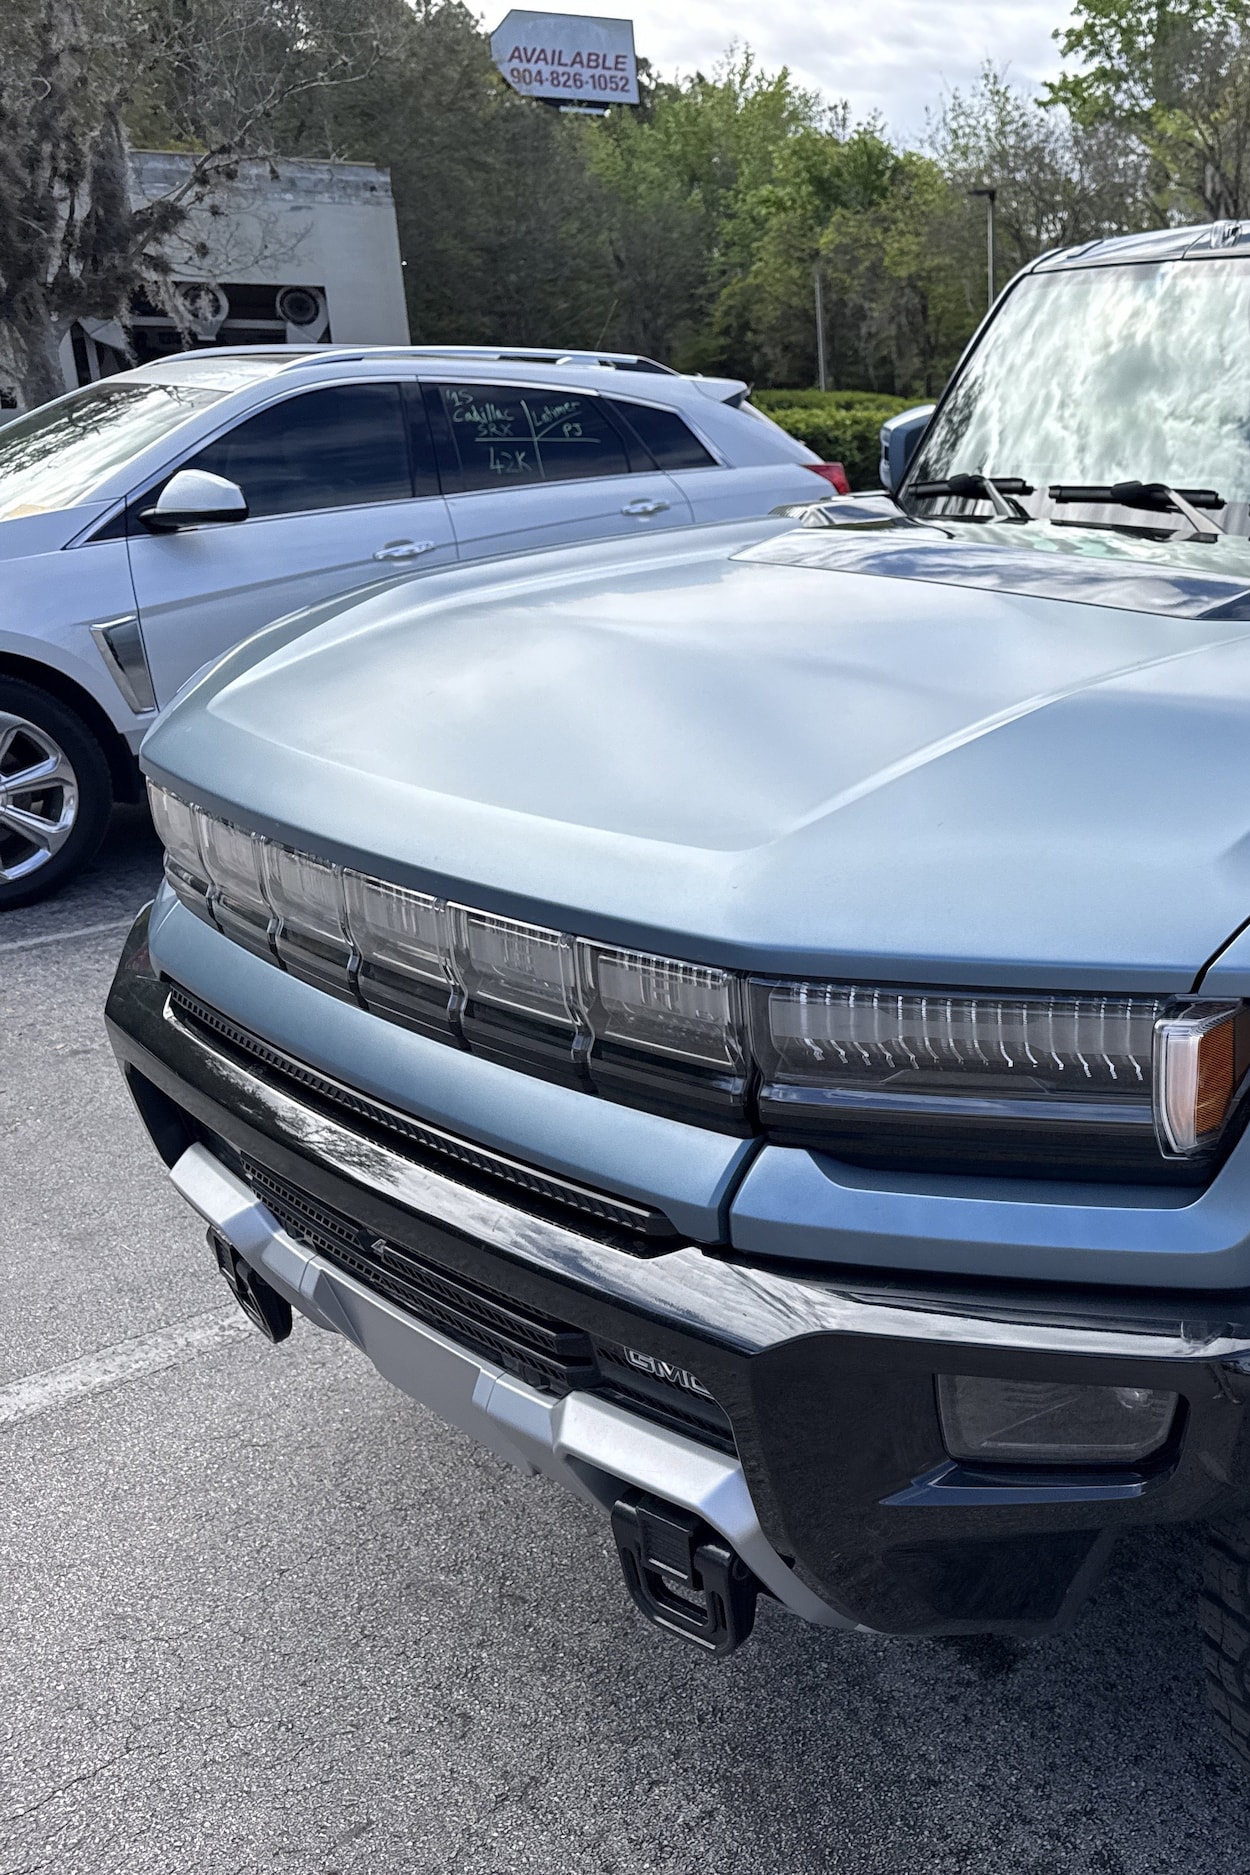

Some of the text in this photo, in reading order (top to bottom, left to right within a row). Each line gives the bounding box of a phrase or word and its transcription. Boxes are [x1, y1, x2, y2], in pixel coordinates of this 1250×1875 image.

[508, 46, 628, 71] AVAILABLE
[477, 423, 514, 437] SRX
[490, 446, 533, 474] 42K
